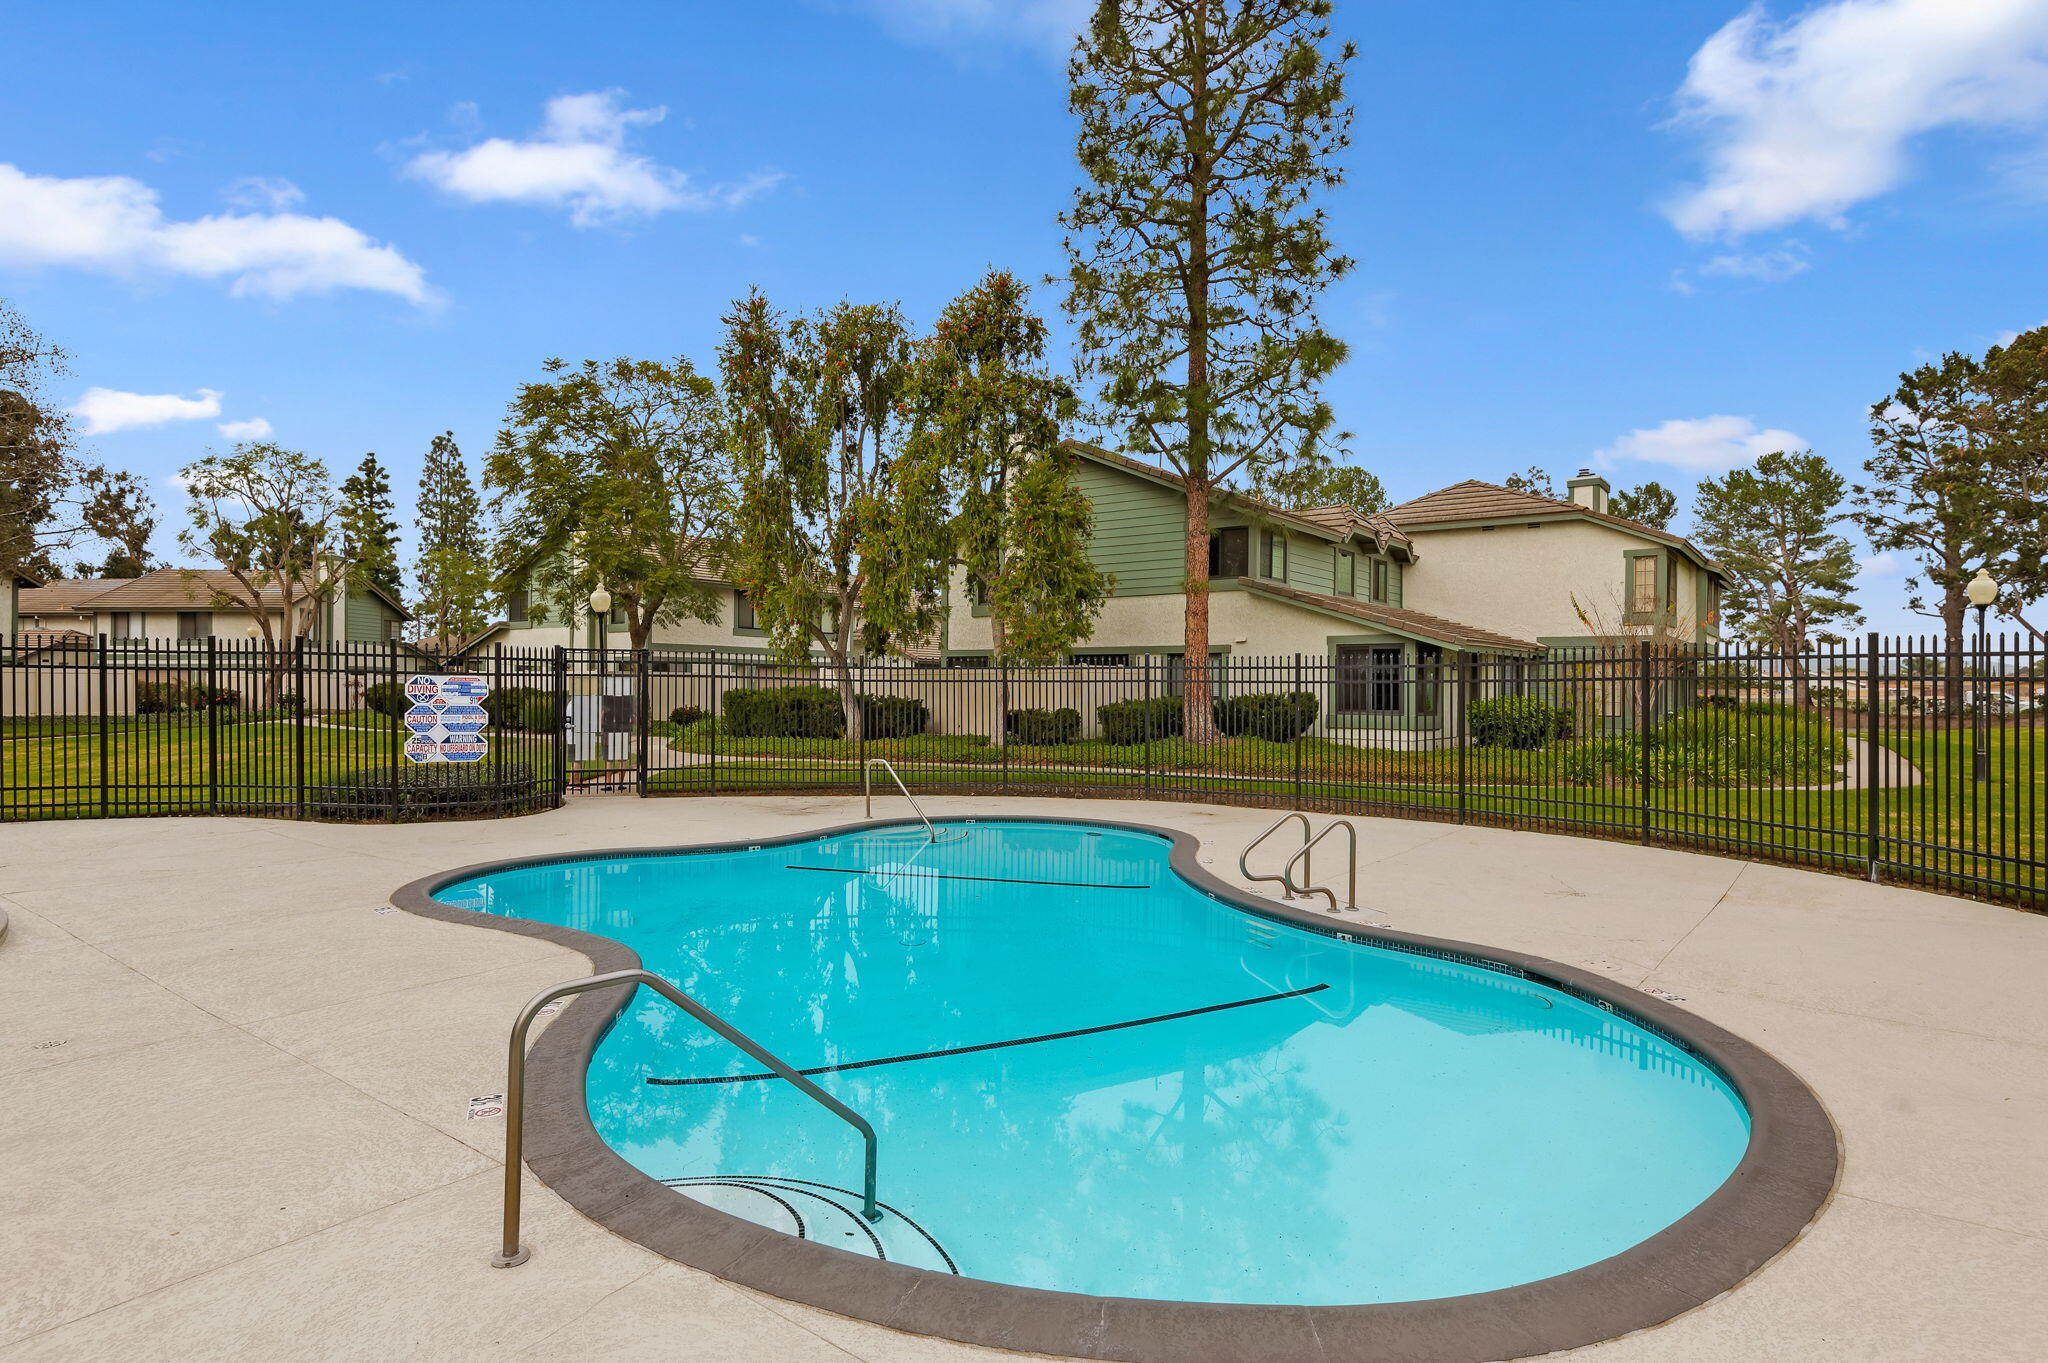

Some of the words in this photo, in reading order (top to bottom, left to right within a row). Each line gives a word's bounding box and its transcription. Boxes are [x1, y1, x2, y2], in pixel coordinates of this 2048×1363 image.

[418, 676, 430, 684] NO
[406, 715, 437, 723] CAUTION
[450, 735, 477, 743] WARNING
[407, 744, 437, 753] CAPACITY
